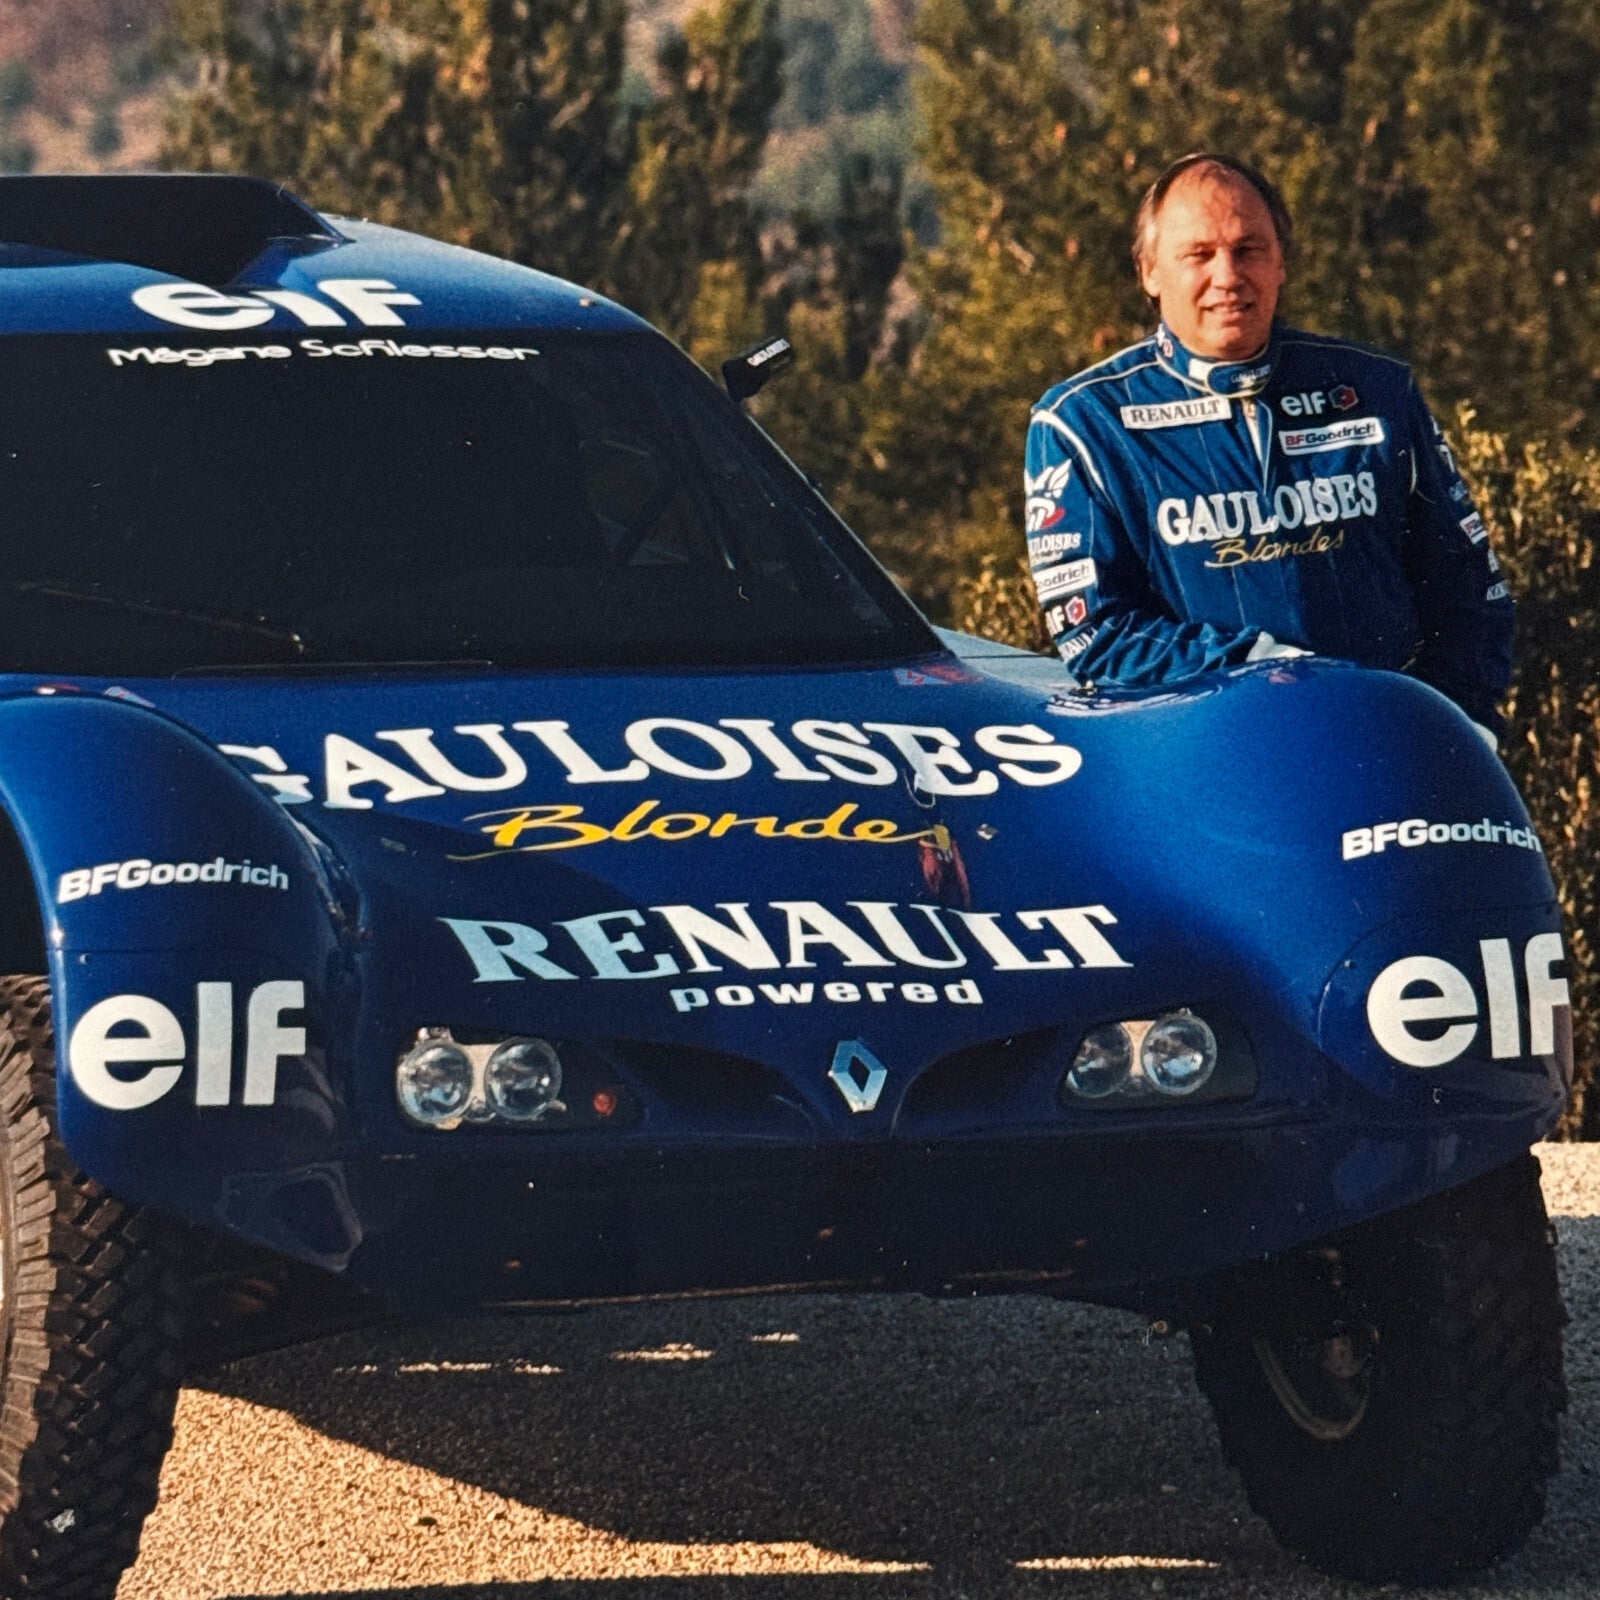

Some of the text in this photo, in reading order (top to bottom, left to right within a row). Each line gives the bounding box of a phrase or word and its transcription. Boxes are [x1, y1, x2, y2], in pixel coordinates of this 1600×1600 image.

[131, 278, 422, 331] elf
[298, 338, 541, 361] Schlesser
[1130, 399, 1222, 424] RENAULT
[1281, 391, 1328, 417] elf
[1284, 421, 1378, 445] BFGoodrich
[1157, 470, 1379, 546] GAULOISES
[1039, 563, 1091, 588] odrich
[1342, 817, 1543, 861] BFGoodrich
[57, 856, 290, 905] BFGoodrich
[437, 902, 1134, 983] RENAULT
[670, 978, 984, 1013] powered
[1366, 932, 1570, 1068] elf
[68, 980, 307, 1111] elf
